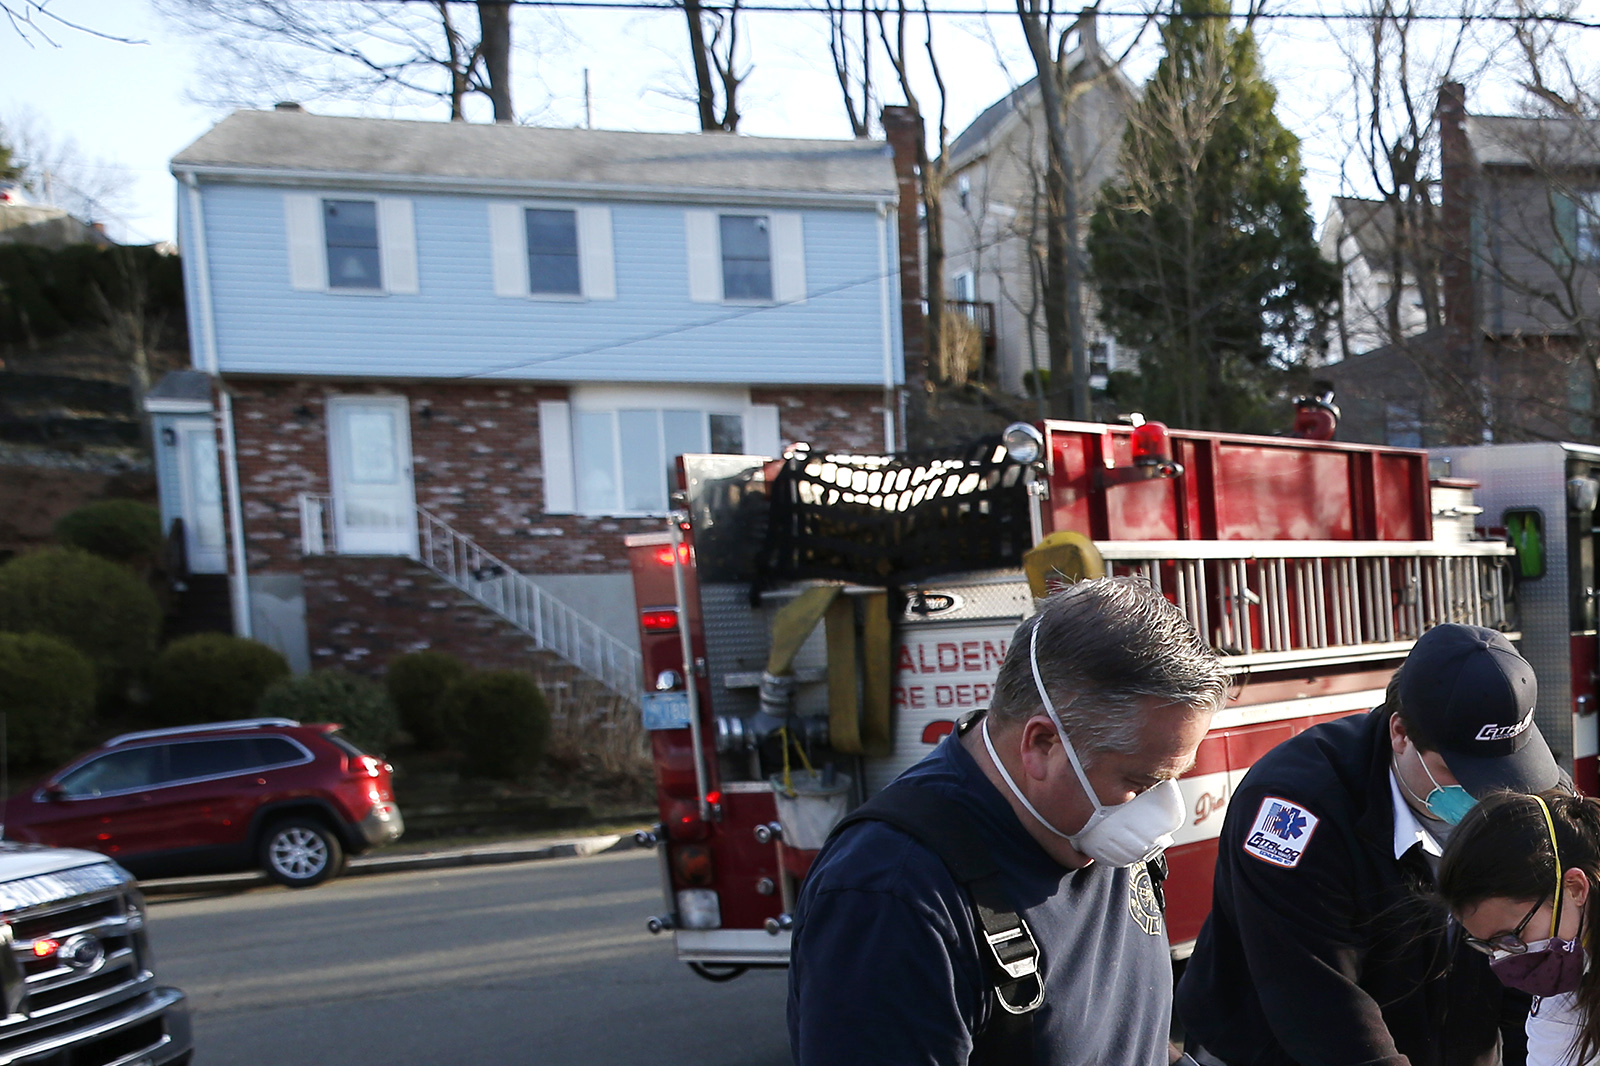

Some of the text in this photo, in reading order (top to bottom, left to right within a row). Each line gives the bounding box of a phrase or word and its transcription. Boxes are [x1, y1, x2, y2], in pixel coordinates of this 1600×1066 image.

[895, 639, 1006, 674] ALDEN
[888, 683, 996, 709] RE DEP
